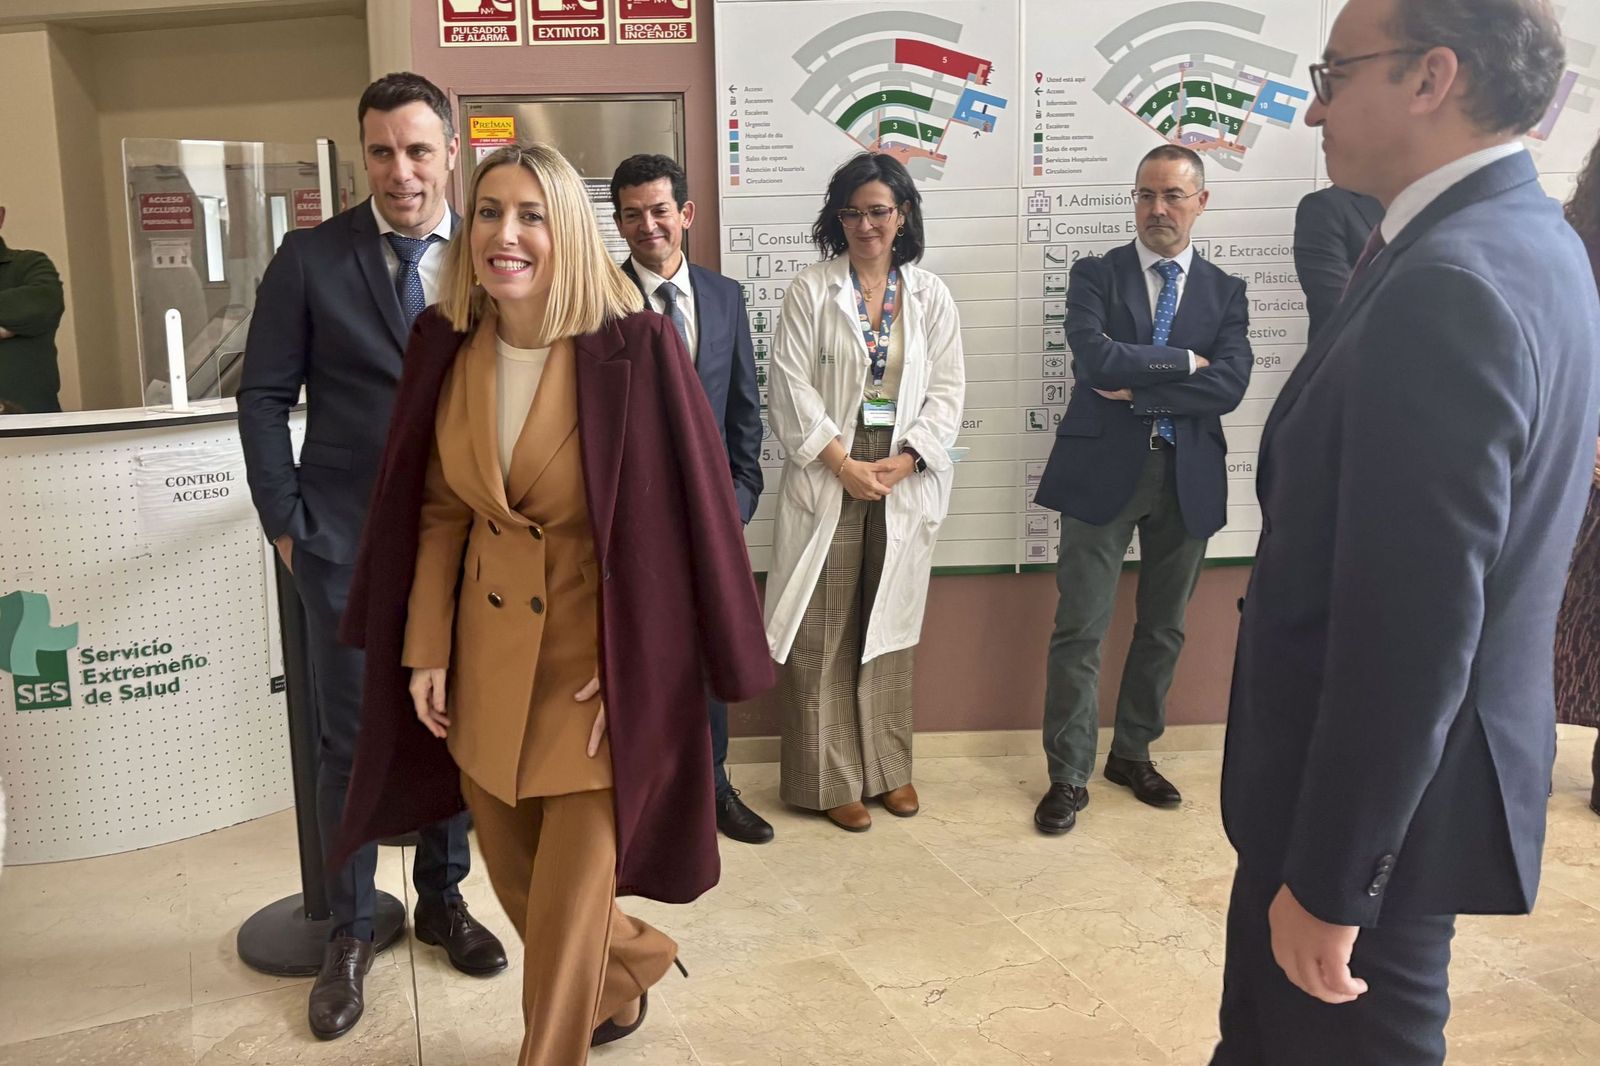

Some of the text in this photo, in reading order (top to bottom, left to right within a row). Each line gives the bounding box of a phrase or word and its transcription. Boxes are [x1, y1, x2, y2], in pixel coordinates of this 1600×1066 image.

[453, 26, 507, 34] PULSADOR
[538, 26, 599, 38] EXTINTOR
[670, 23, 687, 31] DE
[451, 34, 465, 42] DE
[1056, 193, 1132, 207] 1. Admisión
[1056, 221, 1120, 235] Consultas
[758, 232, 816, 246] Consulta
[1214, 245, 1226, 257] 2.
[775, 260, 787, 272] 2.
[758, 288, 770, 300] 3.
[1251, 298, 1304, 311] Torácica
[1250, 326, 1287, 338] estivo
[762, 449, 774, 460] 5.
[166, 471, 234, 488] CONTROL
[172, 487, 230, 502] ACCESO
[80, 640, 172, 664] Servicio
[83, 654, 208, 685] Extremeño
[16, 682, 69, 704] SES
[84, 676, 180, 704] de Salud
